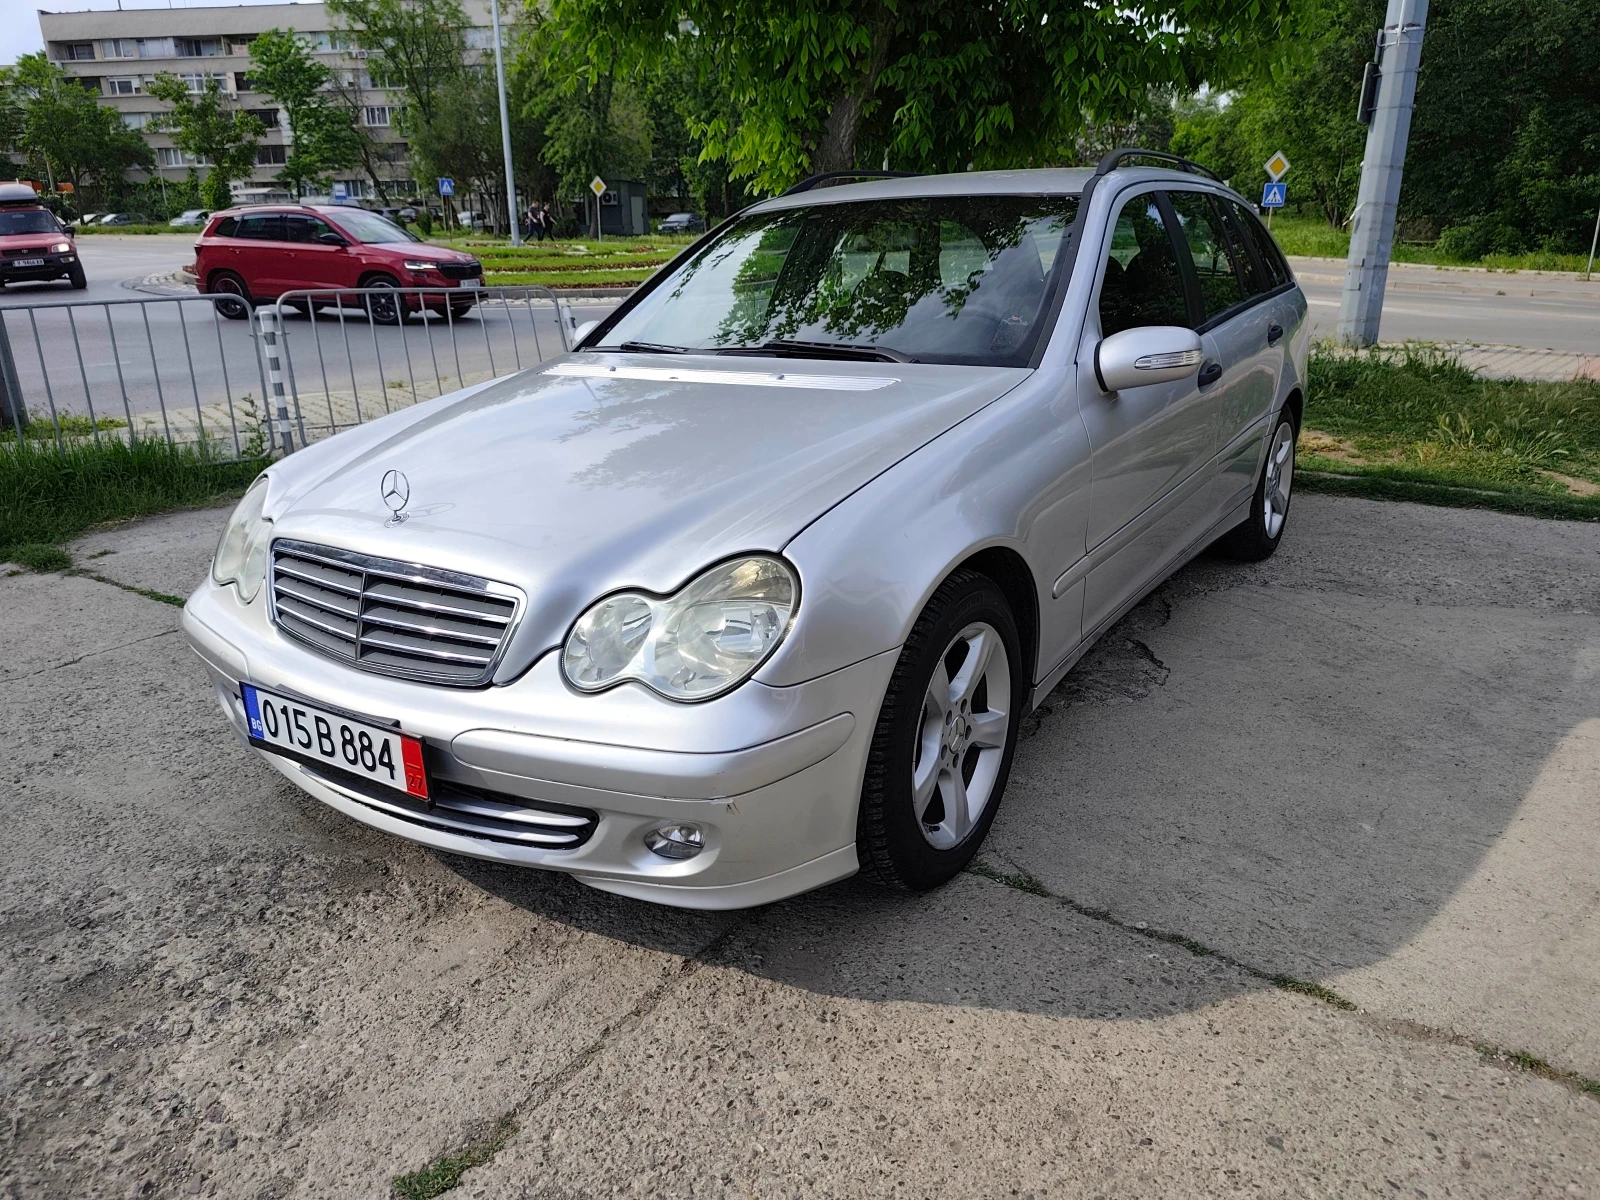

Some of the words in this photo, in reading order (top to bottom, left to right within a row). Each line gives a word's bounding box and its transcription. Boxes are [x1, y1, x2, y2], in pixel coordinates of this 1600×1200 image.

[251, 717, 262, 731] BG
[263, 699, 396, 780] 015B884
[408, 772, 422, 789] 27
